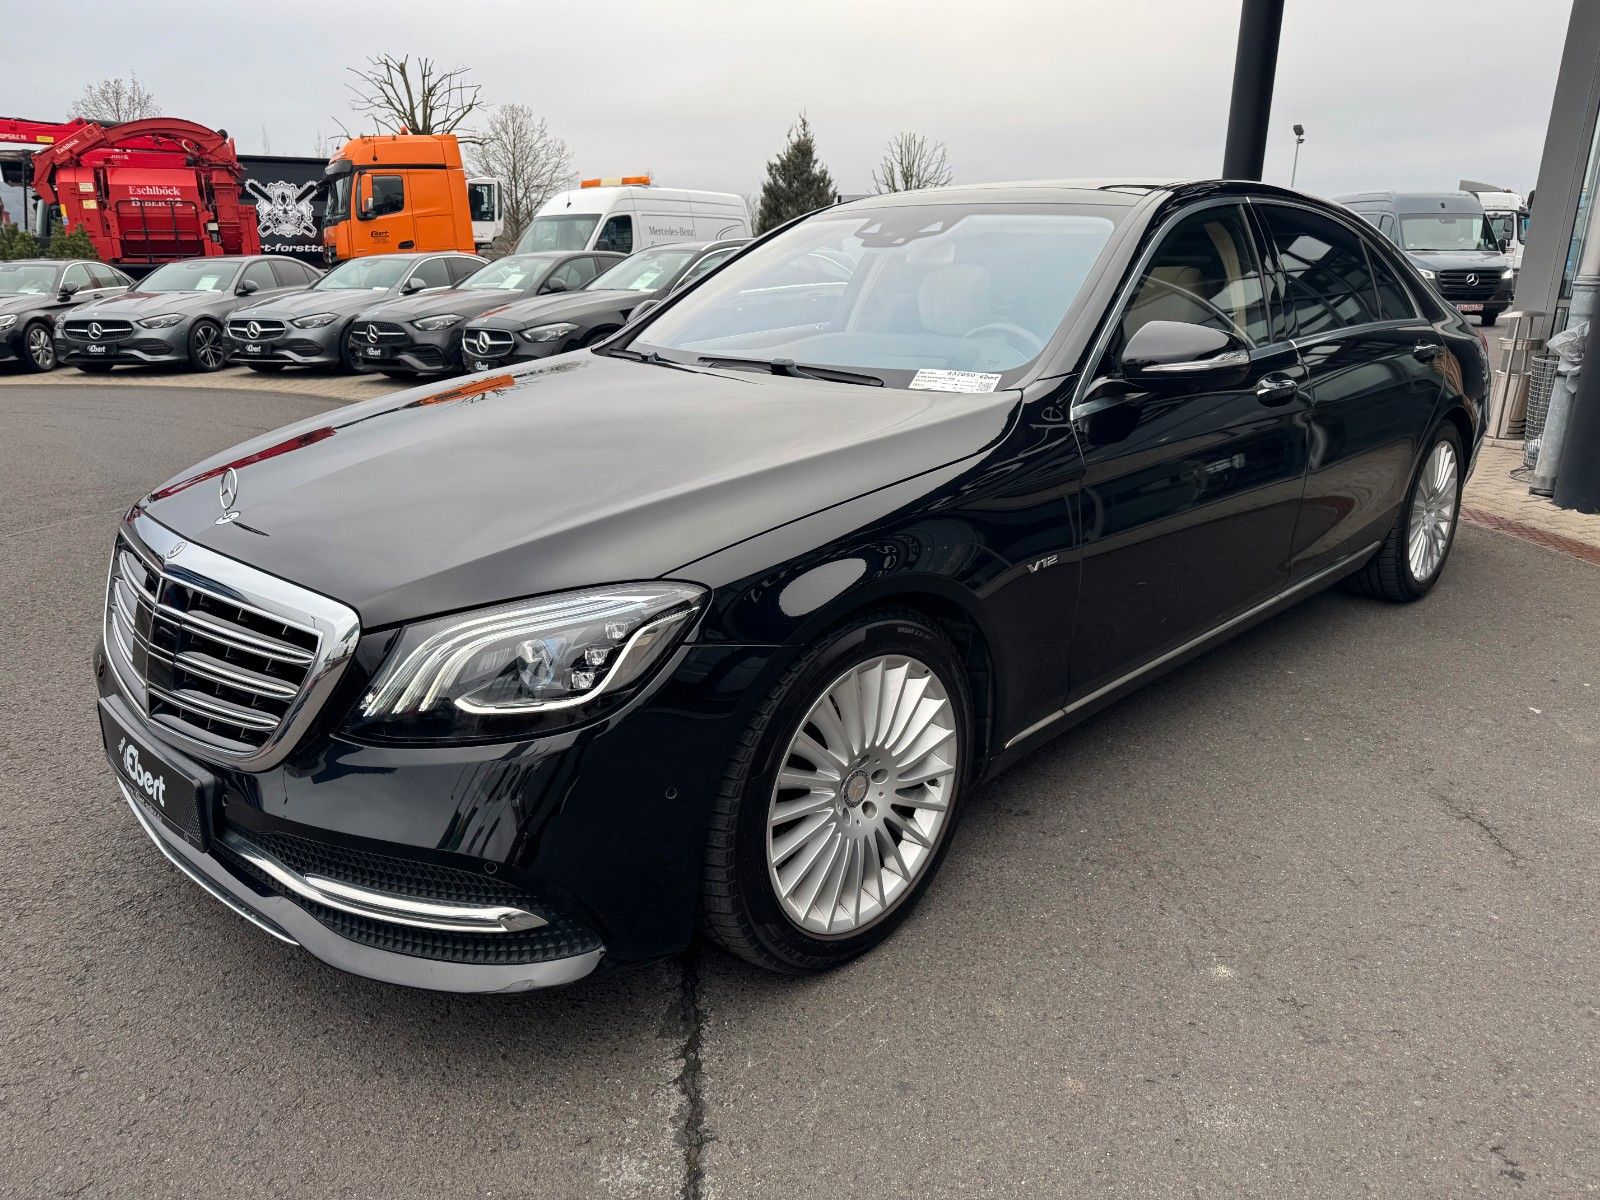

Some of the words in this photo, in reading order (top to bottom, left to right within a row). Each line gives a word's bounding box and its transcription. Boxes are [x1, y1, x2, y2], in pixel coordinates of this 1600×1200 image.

[128, 185, 181, 195] Eschlböck
[1026, 554, 1059, 573] V12
[123, 744, 166, 808] Ebert
